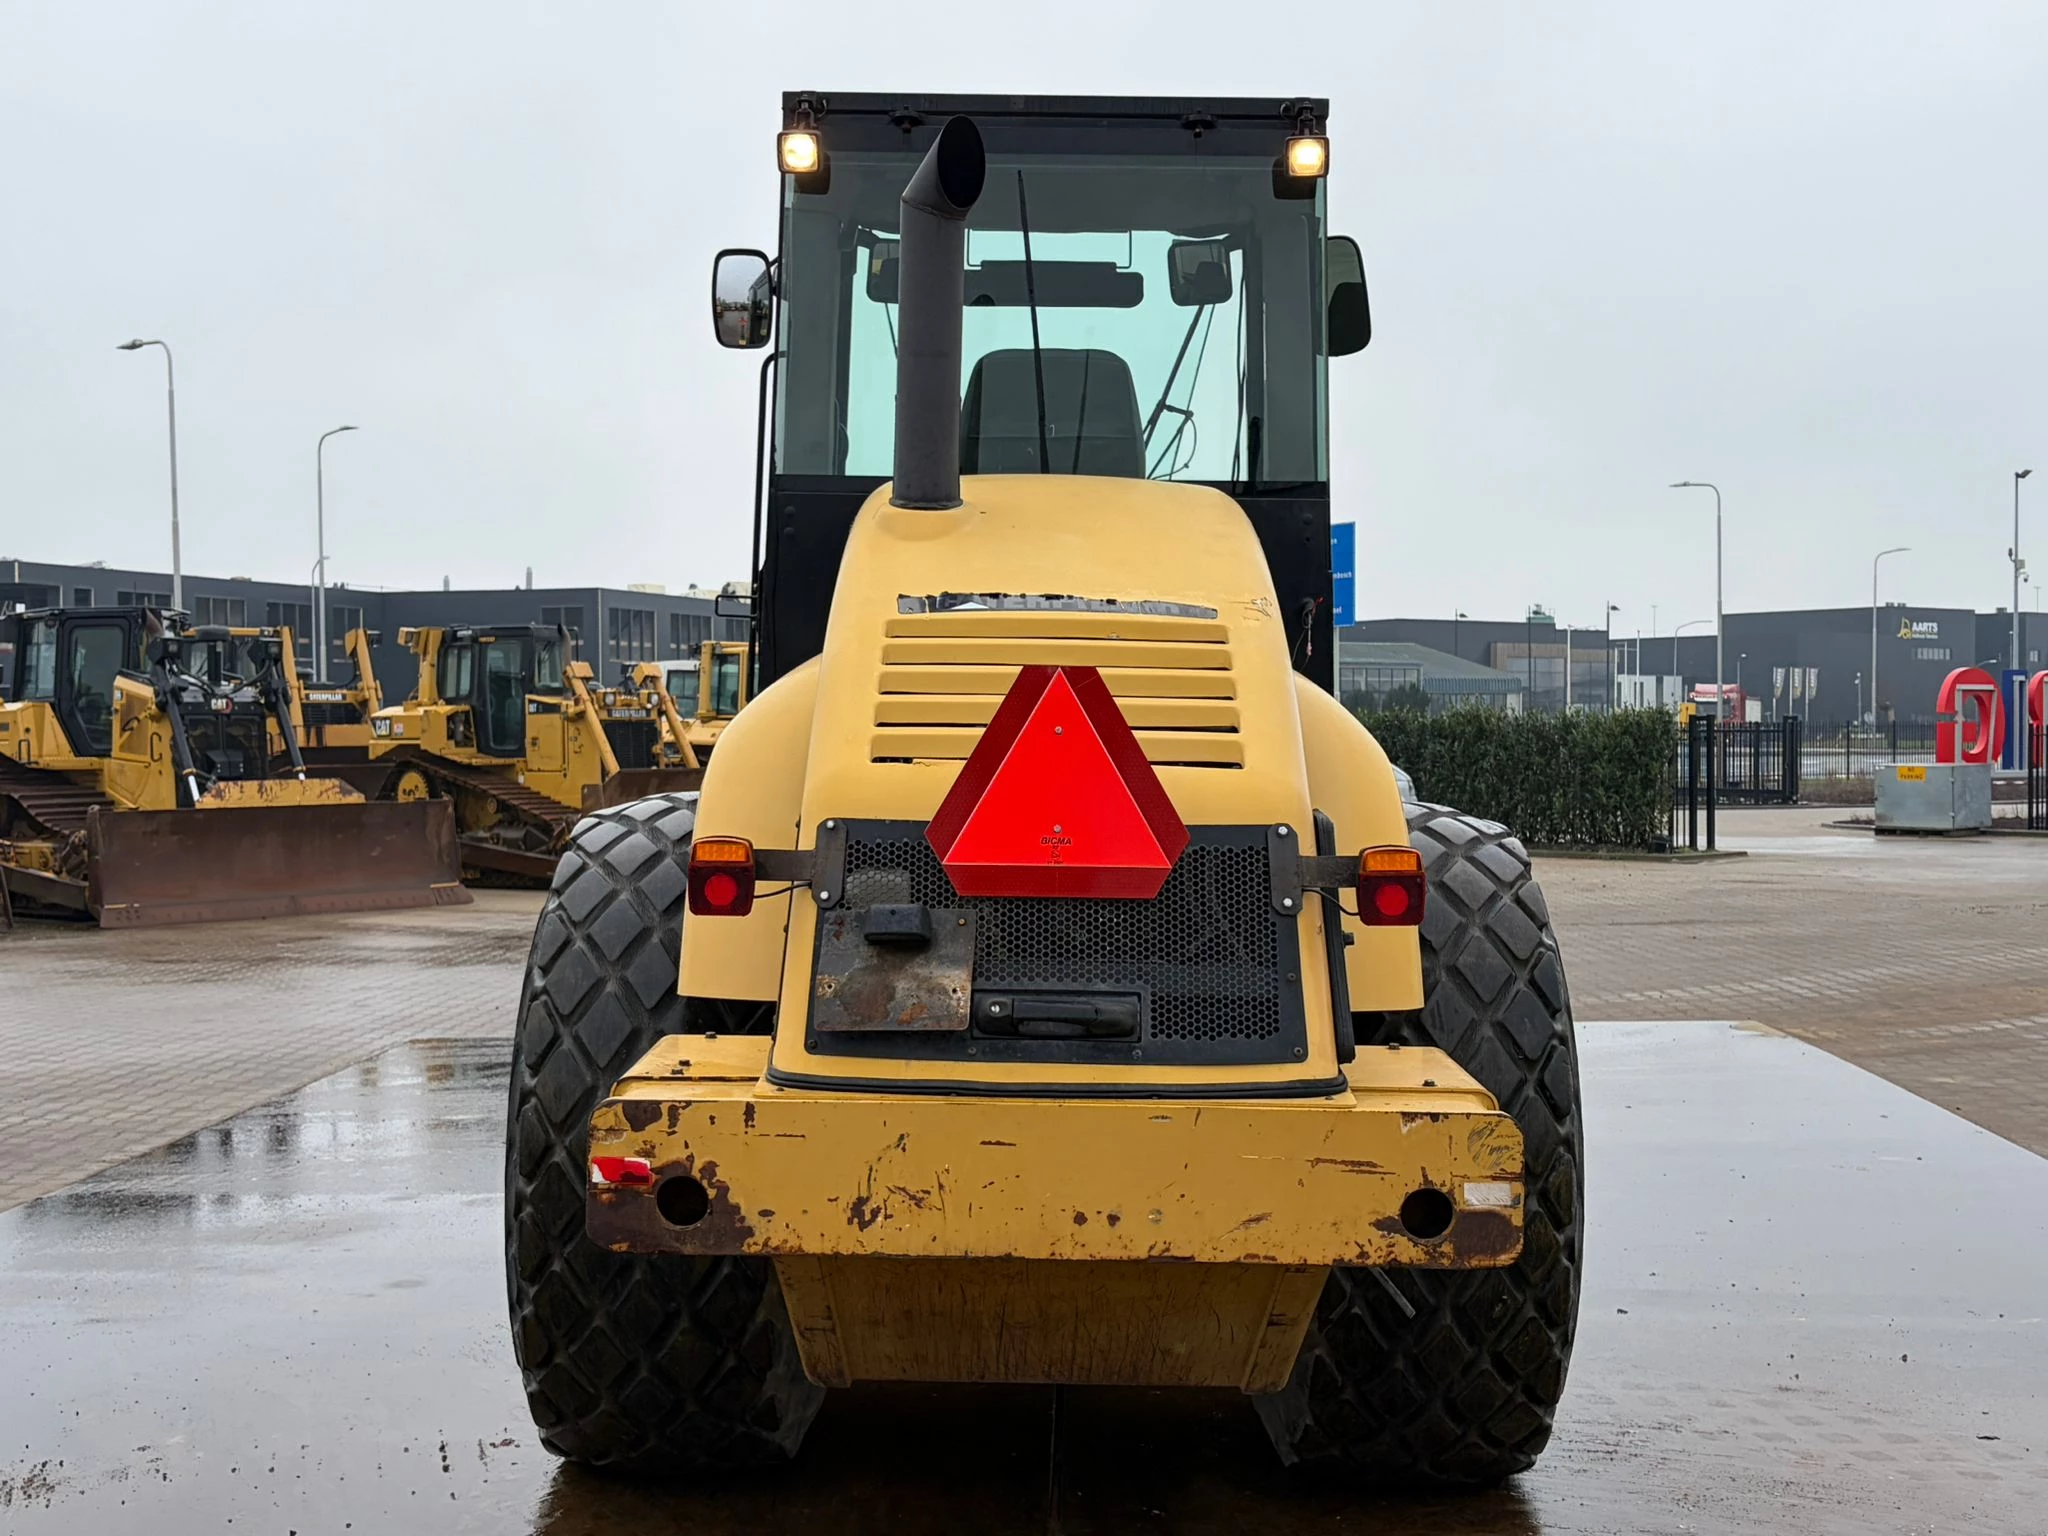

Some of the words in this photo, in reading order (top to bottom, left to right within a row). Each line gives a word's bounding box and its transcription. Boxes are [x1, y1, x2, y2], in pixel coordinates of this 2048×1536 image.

[1911, 621, 1939, 633] AARTS
[211, 698, 227, 710] CAT
[376, 719, 390, 736] CAT
